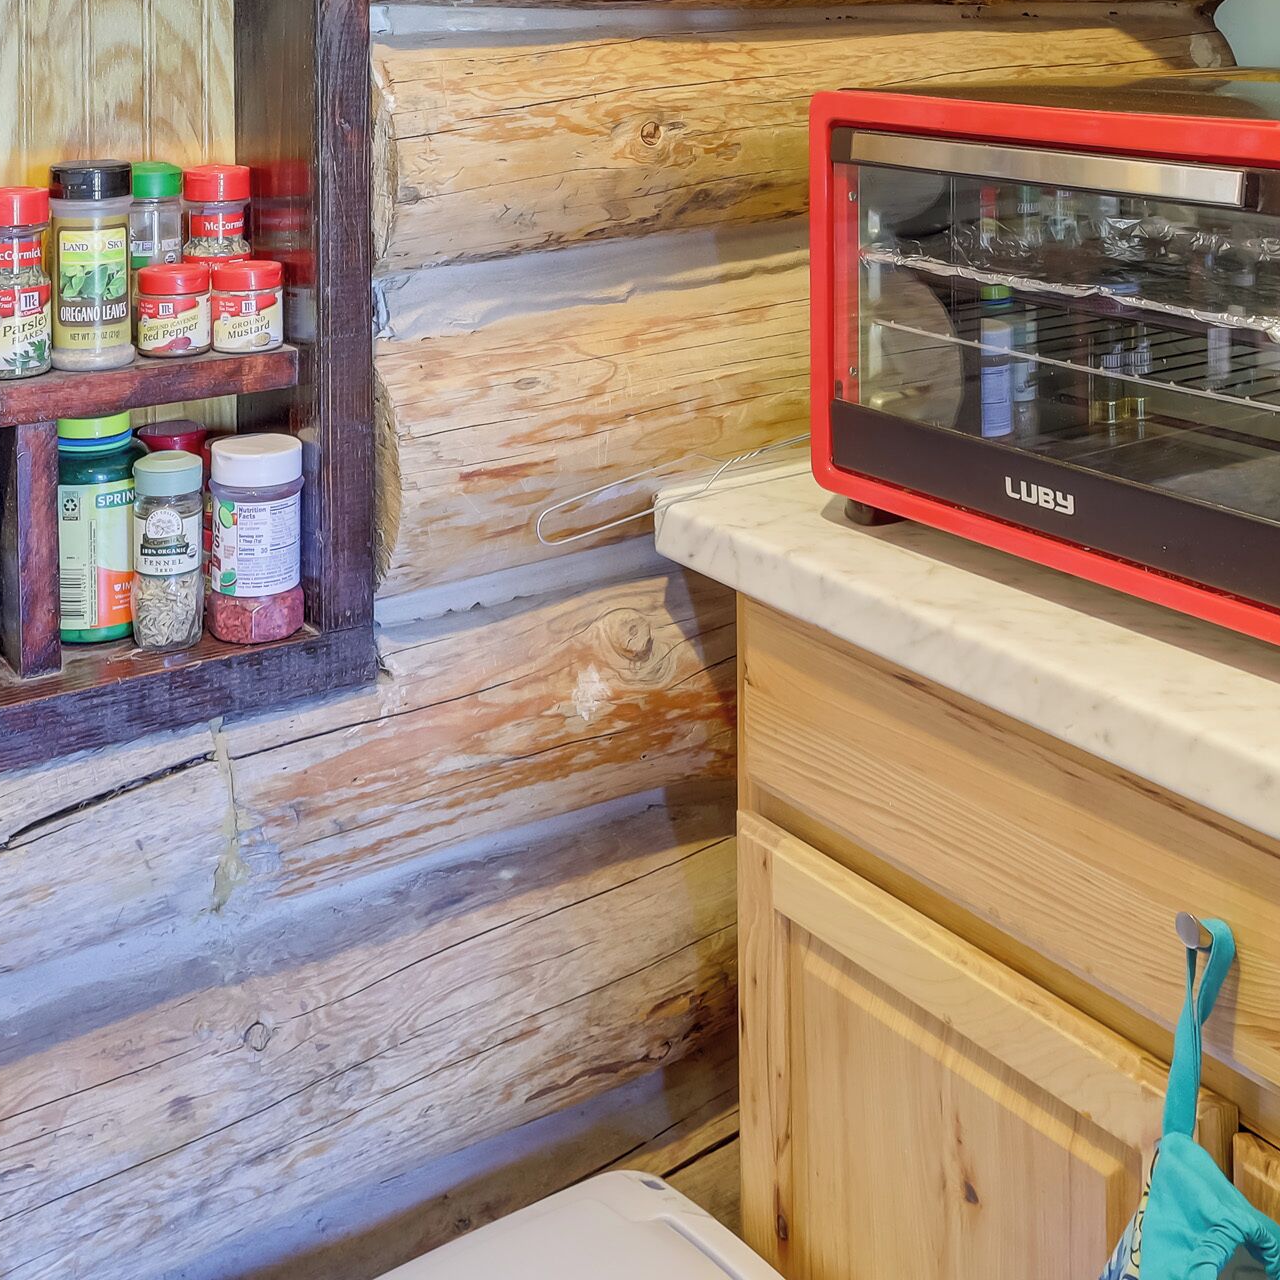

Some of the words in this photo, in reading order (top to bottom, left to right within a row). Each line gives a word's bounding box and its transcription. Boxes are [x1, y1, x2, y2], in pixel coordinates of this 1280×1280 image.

[63, 243, 88, 251] LAND
[108, 241, 123, 249] SKY
[61, 306, 100, 321] OREGANO
[103, 302, 126, 320] LEAVES
[3, 316, 47, 337] Parsley
[143, 332, 159, 341] Red
[163, 321, 198, 337] Pepper
[228, 321, 270, 339] Mustard
[232, 316, 266, 329] GROUND
[12, 330, 43, 345] FLAKES
[1005, 476, 1074, 515] LUBY
[144, 558, 183, 566] FENNEL
